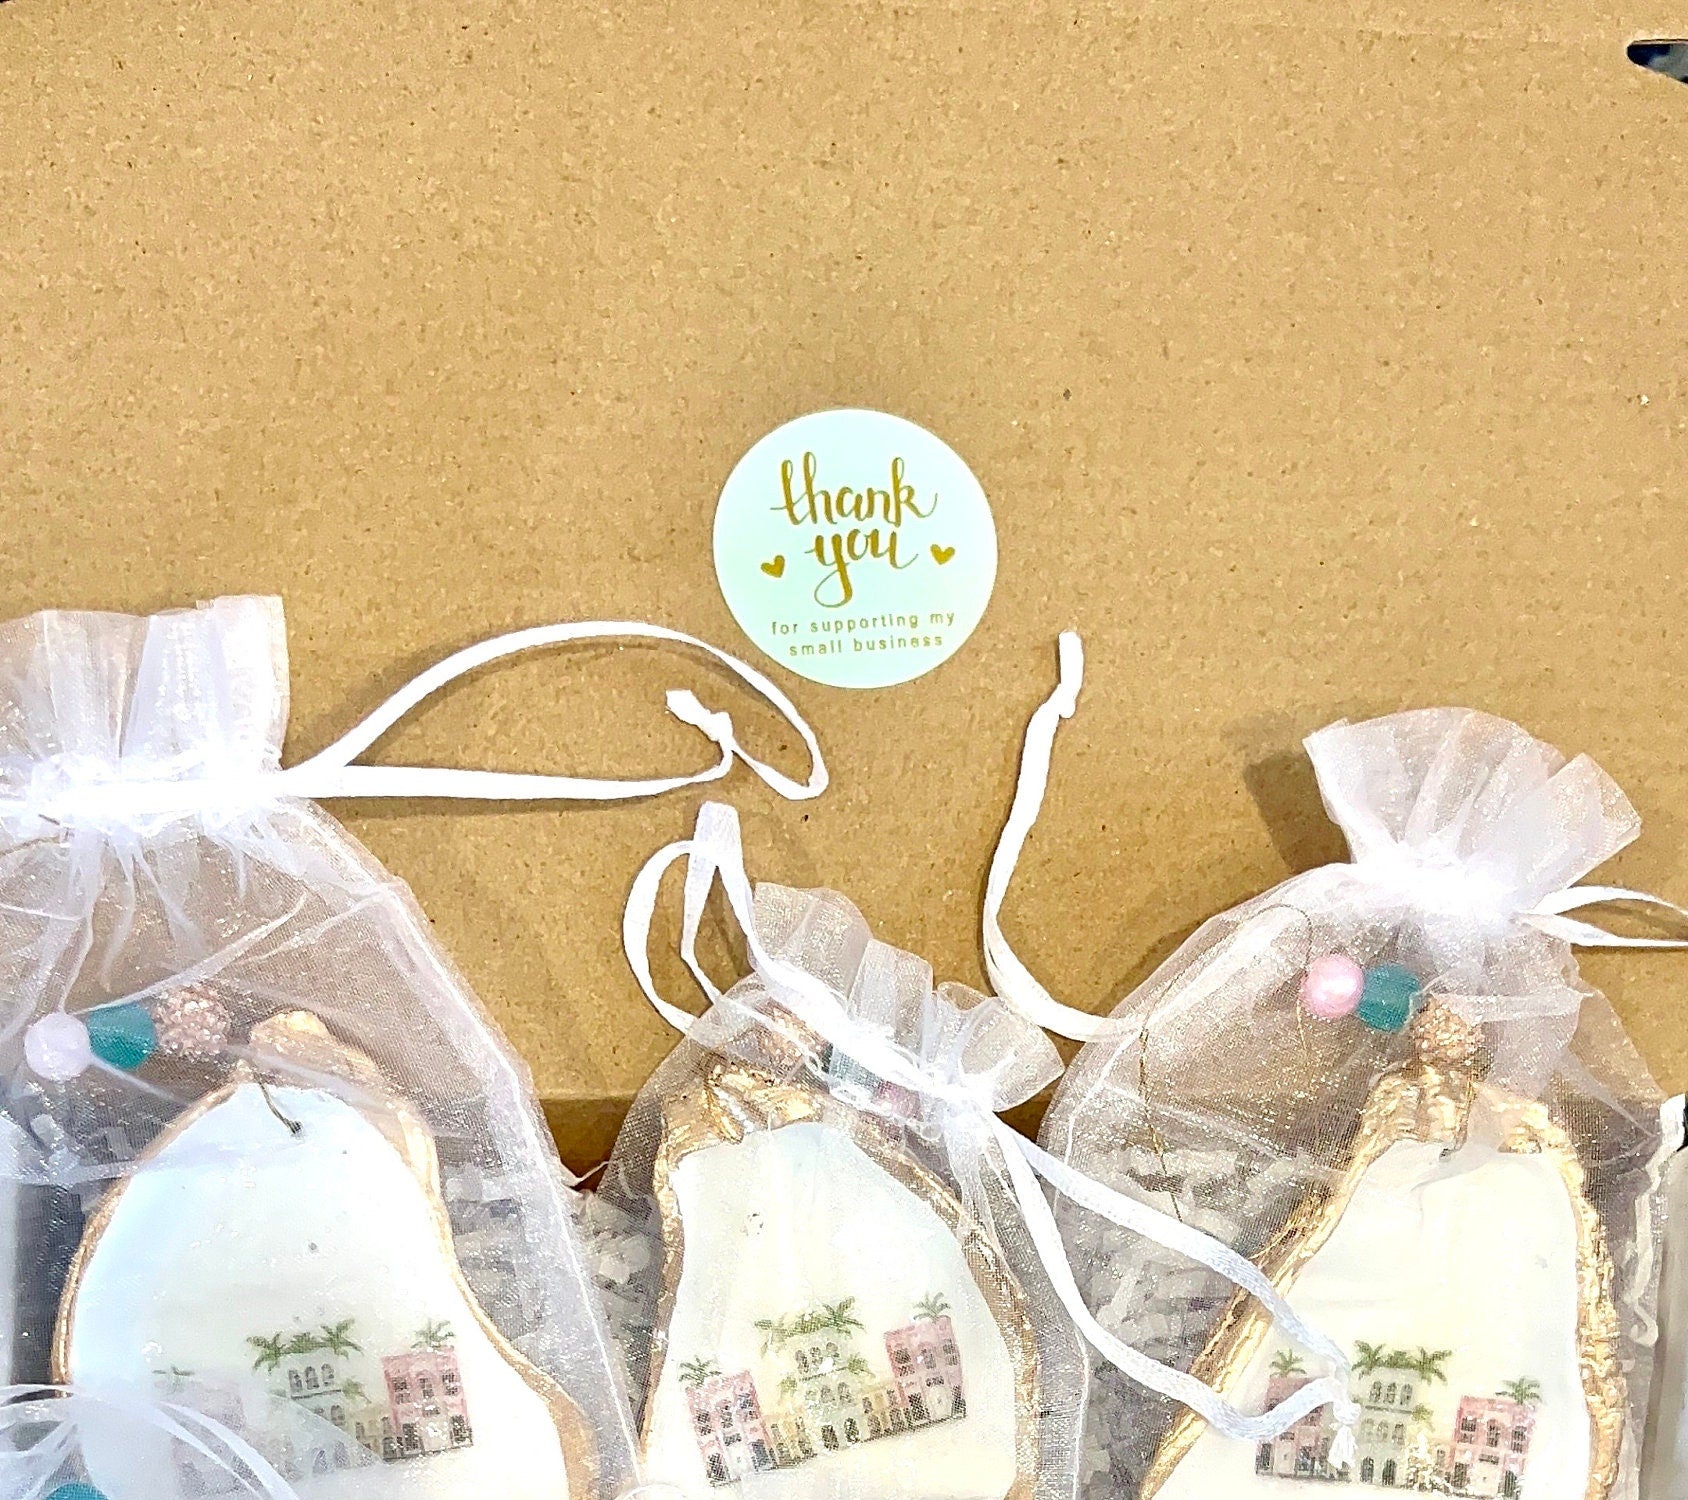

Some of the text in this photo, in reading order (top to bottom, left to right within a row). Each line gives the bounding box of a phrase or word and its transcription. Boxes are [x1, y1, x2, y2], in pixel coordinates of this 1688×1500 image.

[770, 451, 938, 527] thank
[804, 528, 919, 608] you
[771, 612, 955, 635] for supporting my
[790, 635, 942, 656] small business
